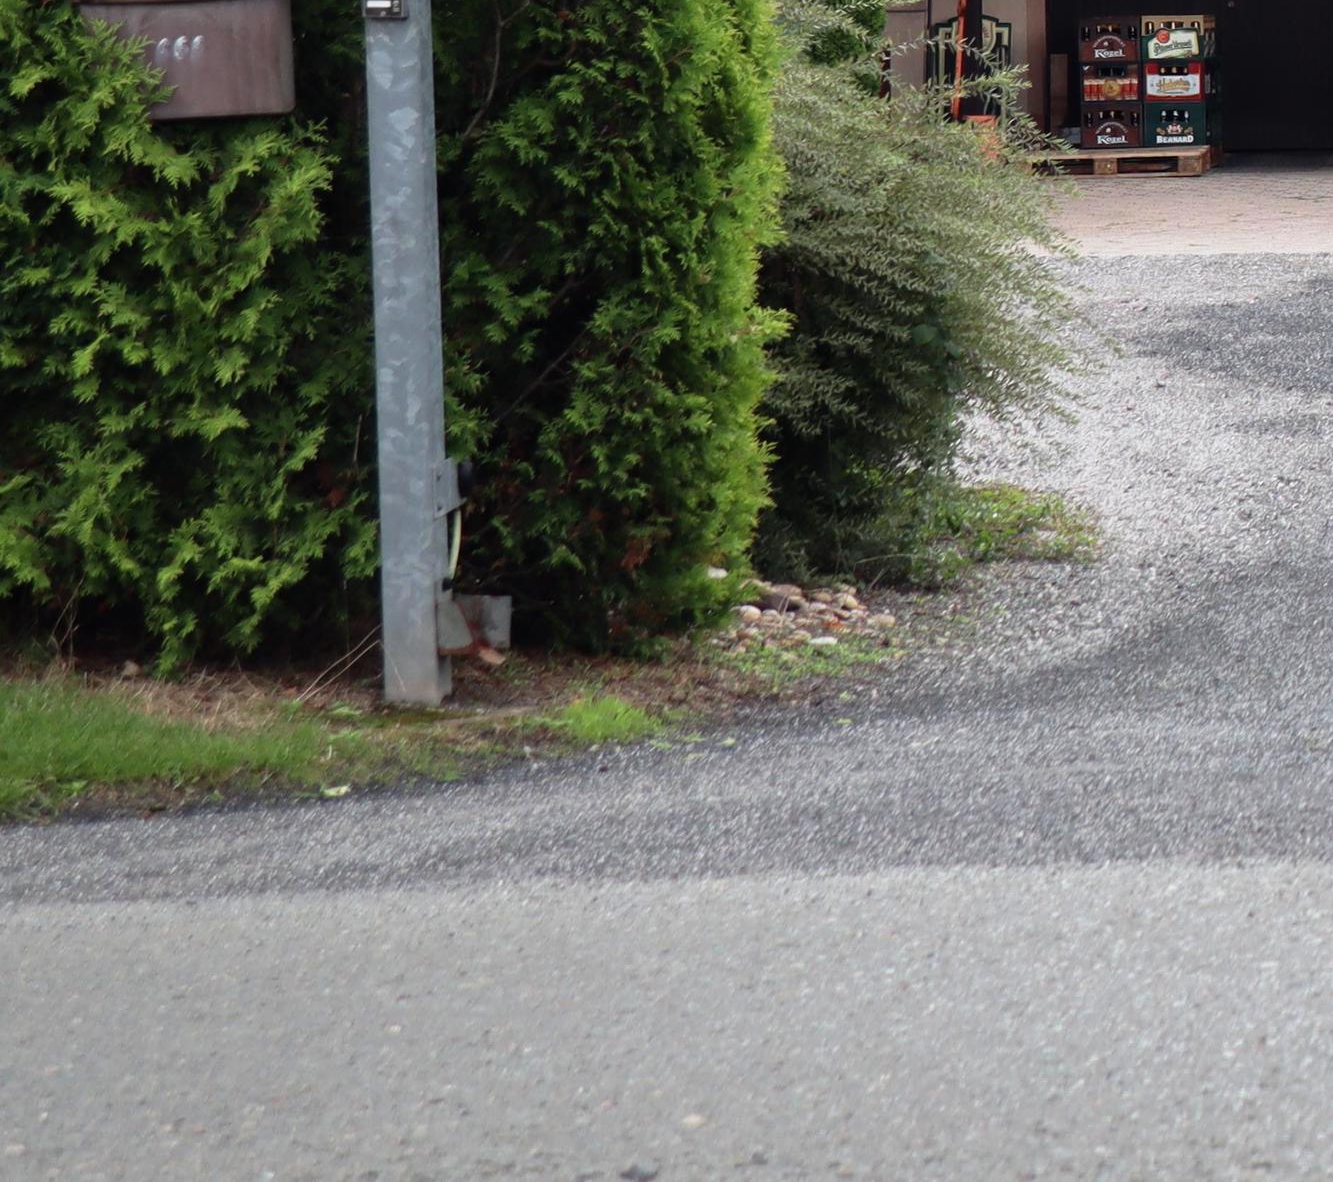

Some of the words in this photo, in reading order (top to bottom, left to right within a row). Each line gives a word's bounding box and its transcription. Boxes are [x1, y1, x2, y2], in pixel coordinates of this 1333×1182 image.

[1094, 49, 1125, 58] Kozel
[1097, 135, 1128, 144] Kozel
[1156, 135, 1194, 144] BERNARD
